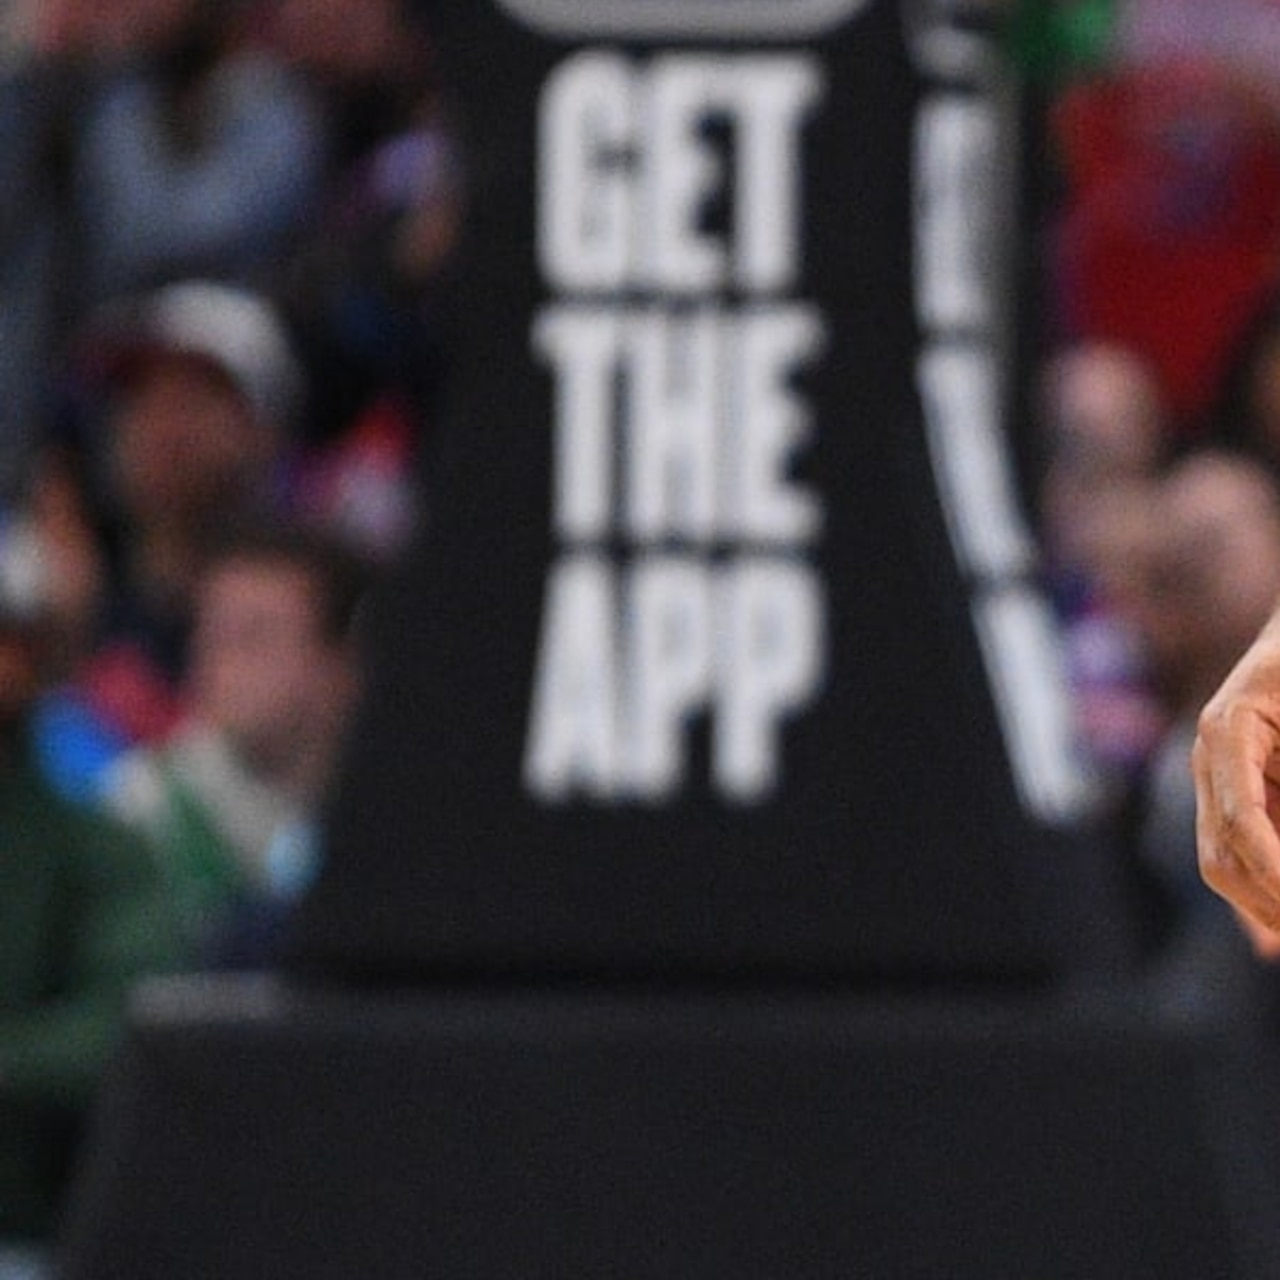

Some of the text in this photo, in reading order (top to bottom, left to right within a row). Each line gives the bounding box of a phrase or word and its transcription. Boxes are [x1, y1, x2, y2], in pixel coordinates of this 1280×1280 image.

[535, 49, 822, 293] GET
[532, 302, 824, 542] THE
[523, 552, 827, 800] APP
